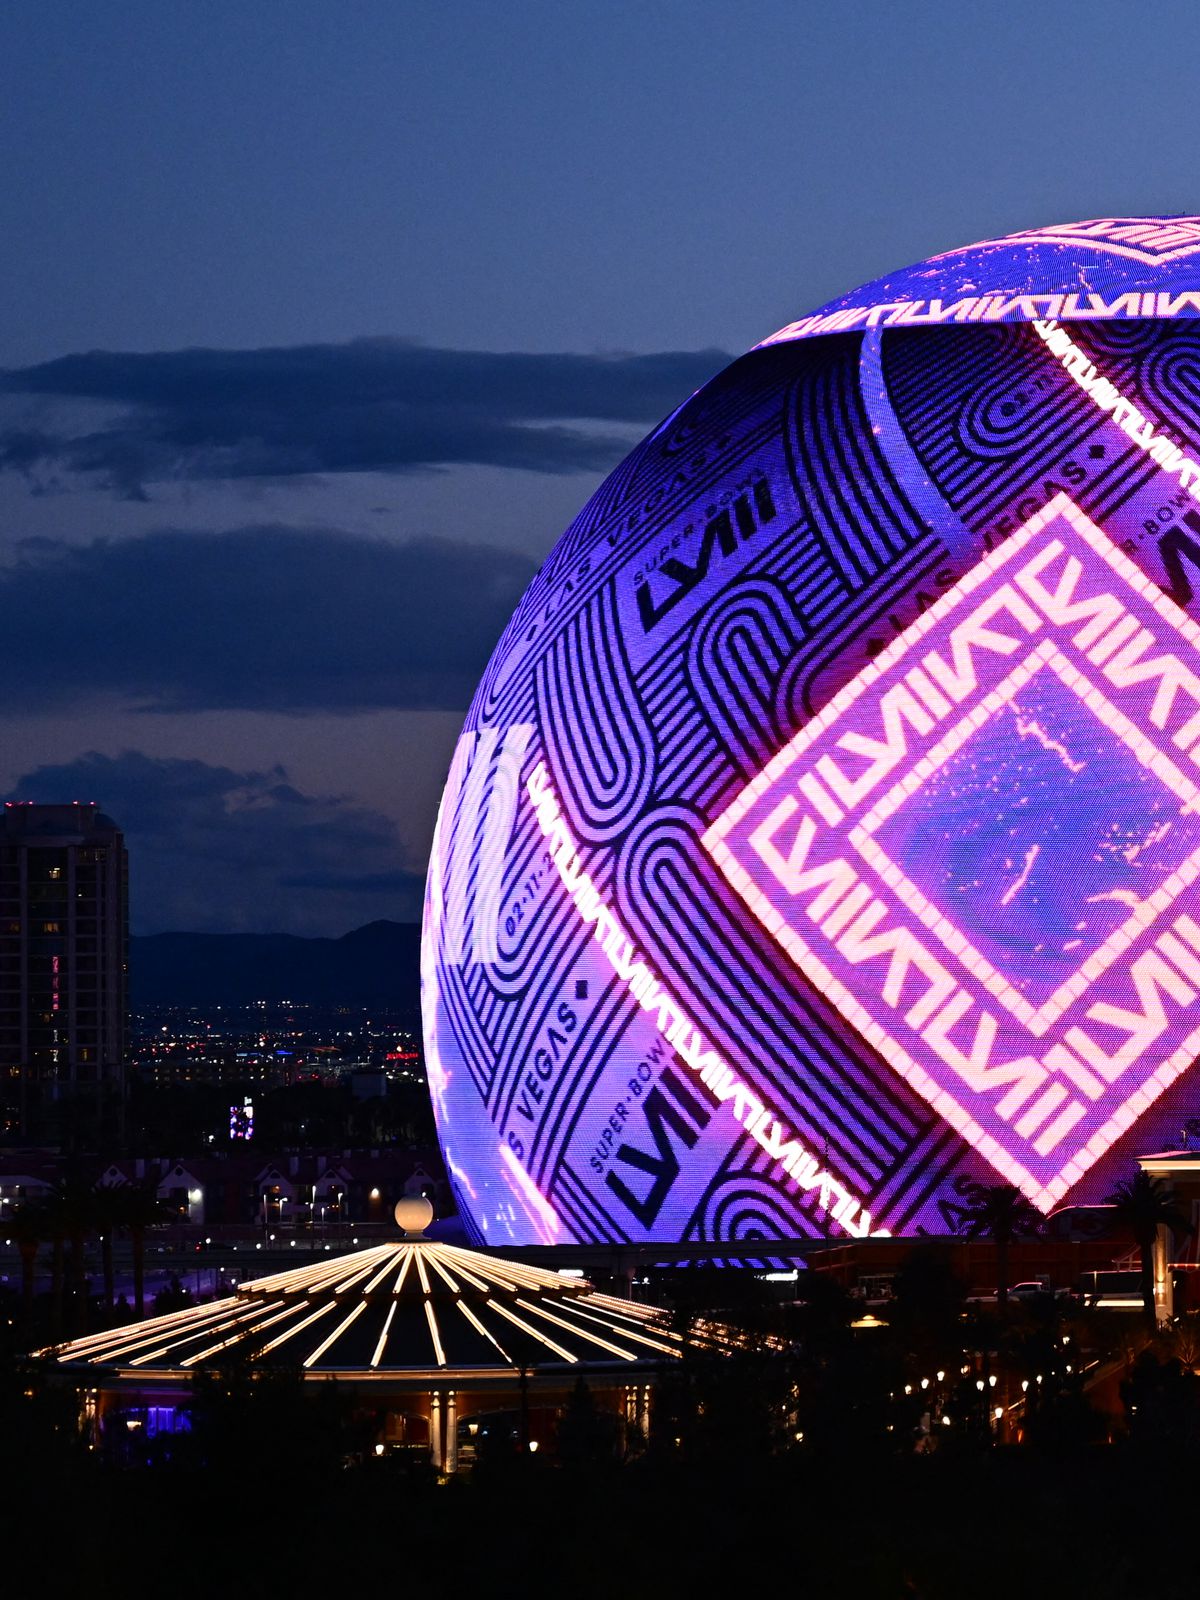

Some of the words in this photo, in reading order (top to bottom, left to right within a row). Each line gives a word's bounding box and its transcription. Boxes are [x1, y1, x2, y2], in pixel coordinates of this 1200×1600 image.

[1143, 488, 1190, 535] BOW
[517, 1002, 577, 1122] VEGAS
[590, 1102, 629, 1173] SUPER
[628, 1038, 665, 1096] BOW
